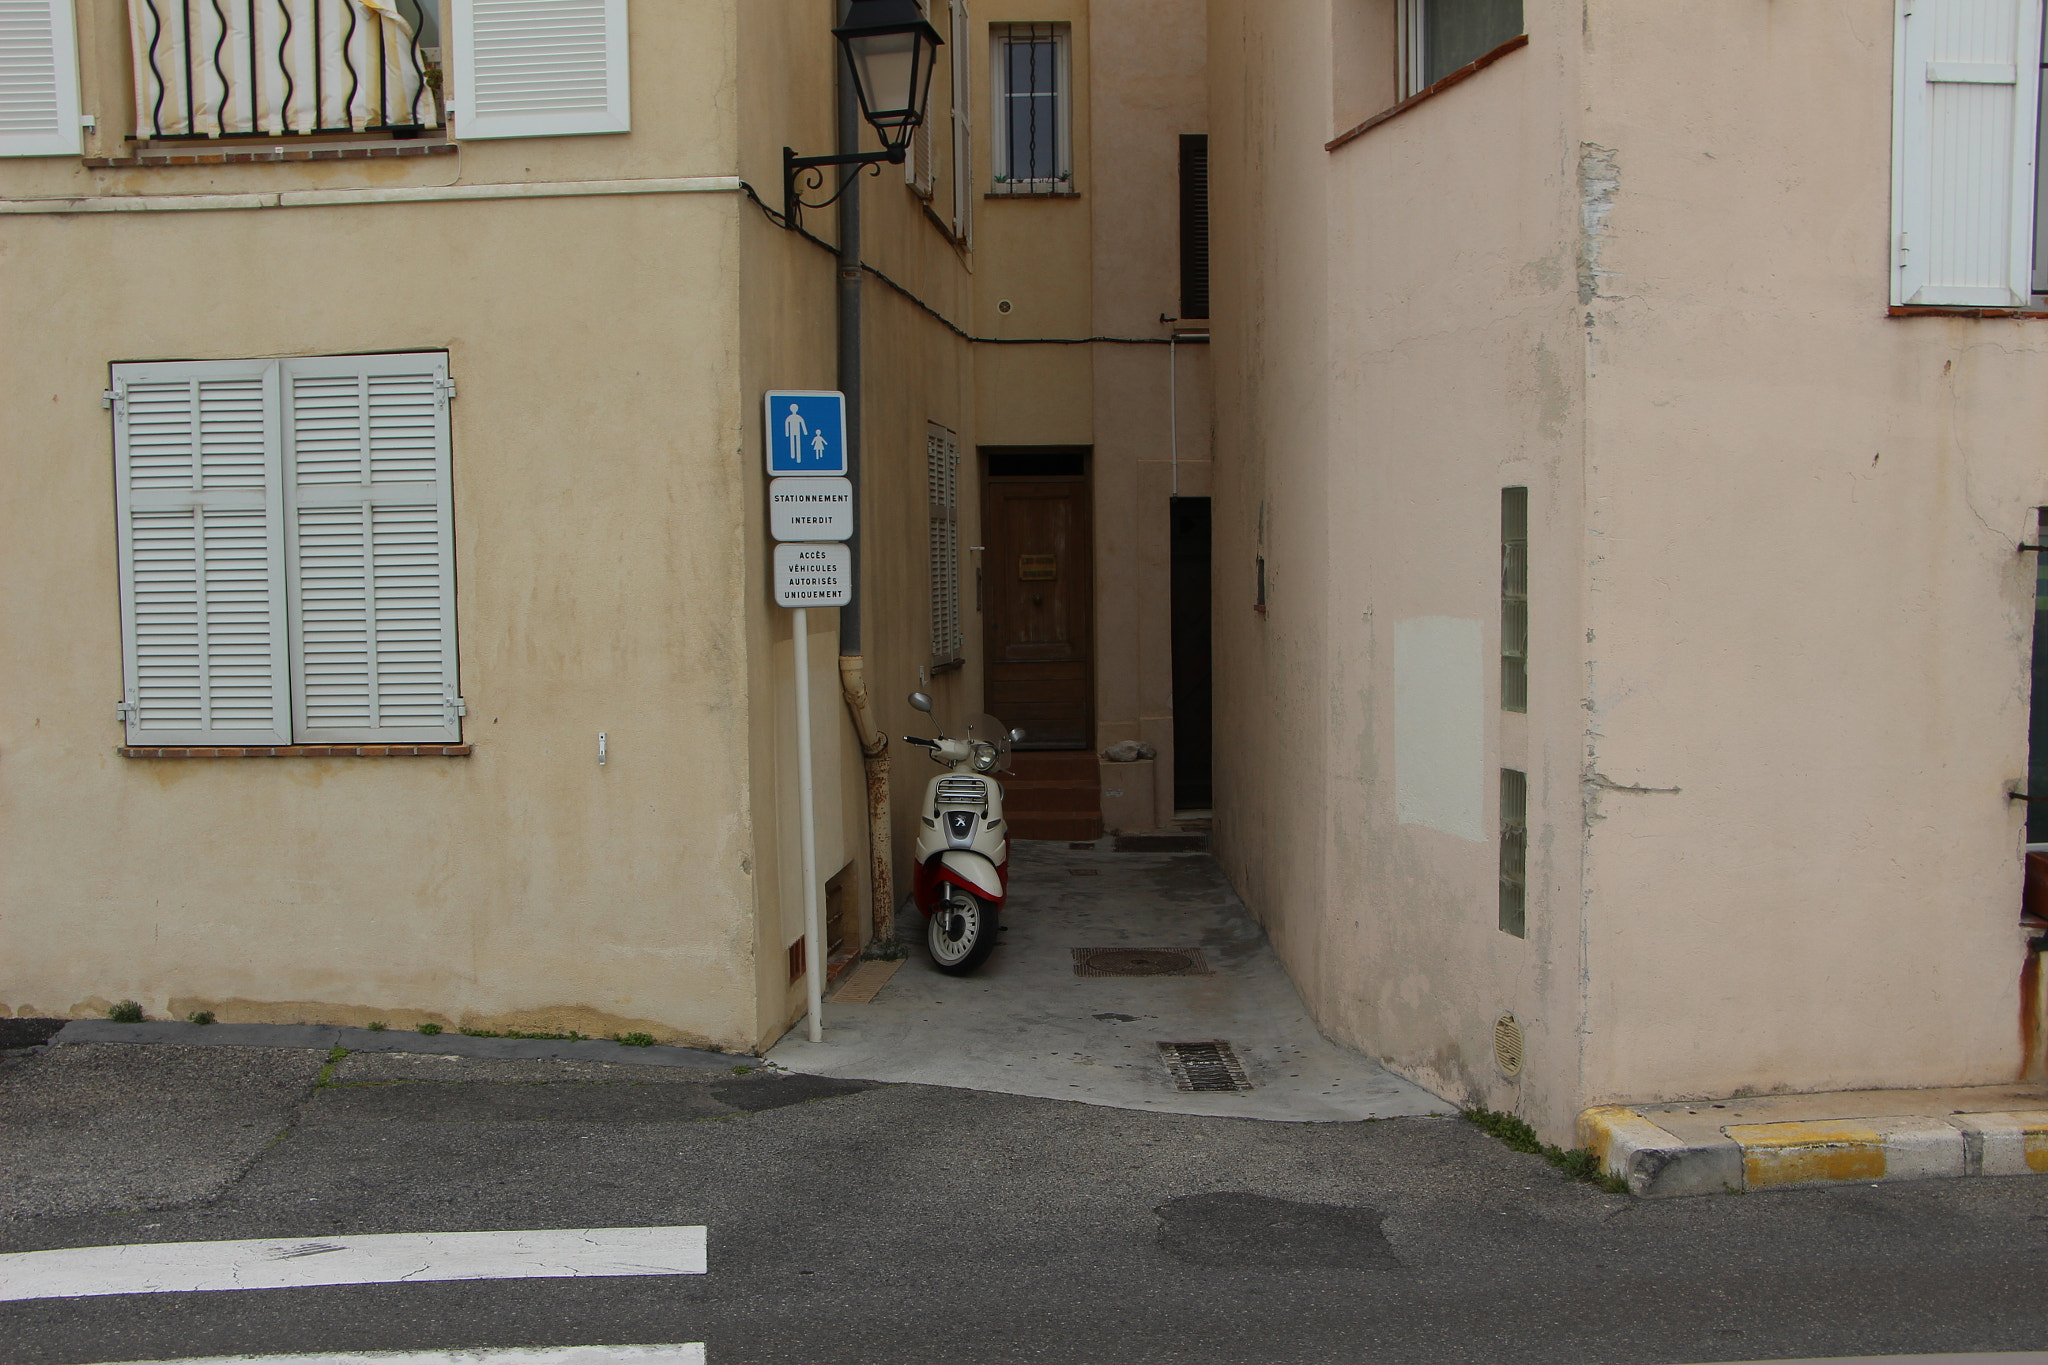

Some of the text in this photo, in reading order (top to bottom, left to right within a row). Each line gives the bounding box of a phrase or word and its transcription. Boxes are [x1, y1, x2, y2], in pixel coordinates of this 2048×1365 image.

[774, 495, 849, 503] STATIONNEMENT
[799, 551, 826, 559] ACCÈS
[788, 564, 837, 572] VÉHICULES
[789, 577, 837, 585] AUTORISÉS
[784, 591, 842, 599] UNIQUEMENT
